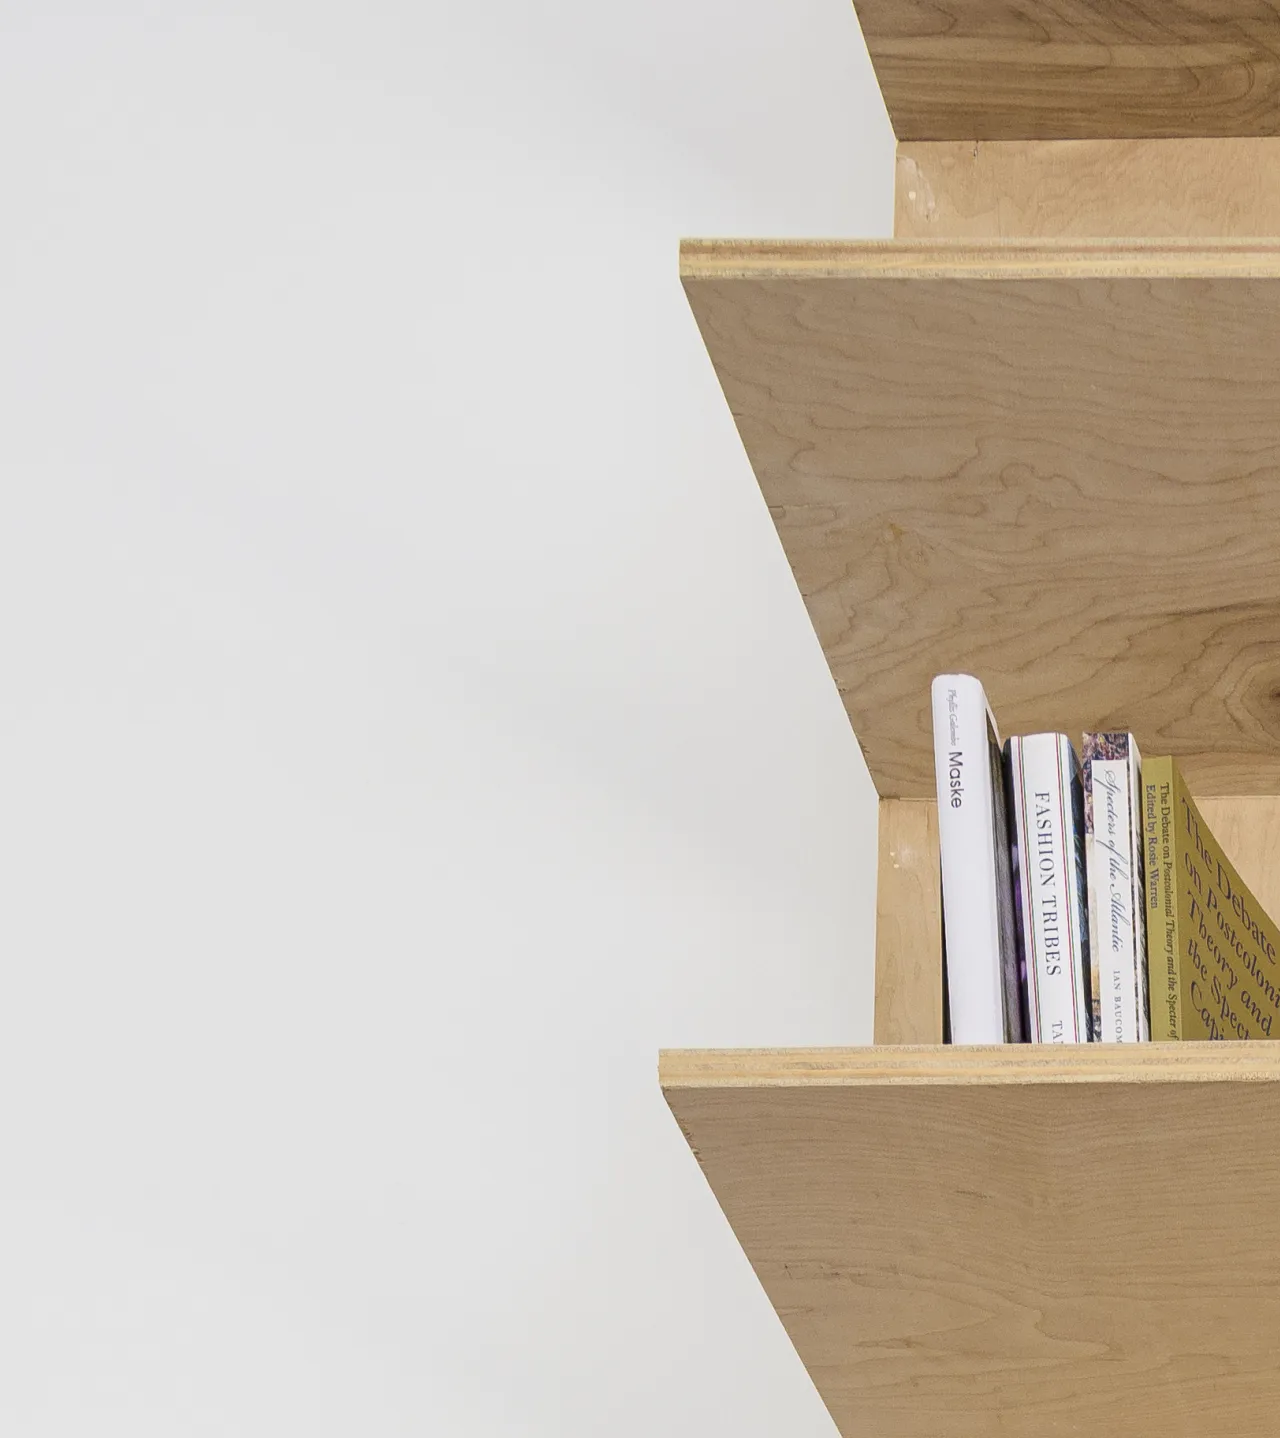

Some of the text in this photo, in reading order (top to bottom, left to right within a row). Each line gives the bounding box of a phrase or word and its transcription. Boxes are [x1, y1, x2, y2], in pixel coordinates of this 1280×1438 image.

[949, 752, 963, 809] Maske
[1034, 791, 1061, 977] FASHION TRIBES
[1146, 784, 1158, 908] Edited by Rosie Warren
[1160, 782, 1179, 1037] The Debate on Postcolonial Theory and the Specter of
[1113, 970, 1121, 992] IAN
